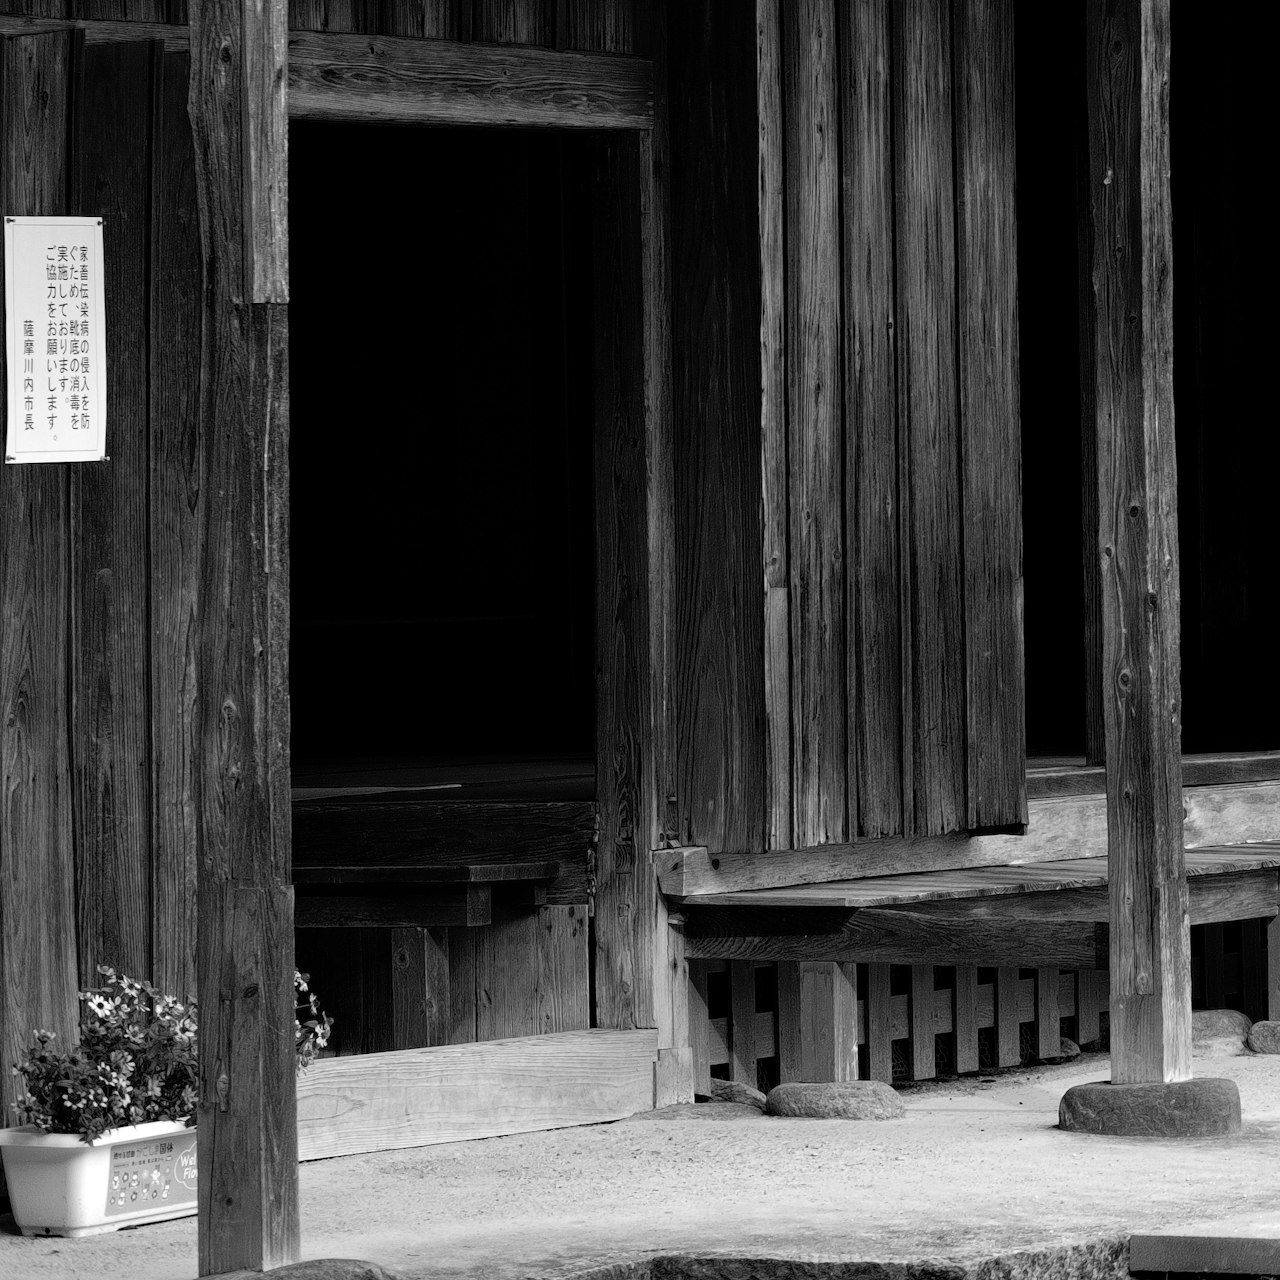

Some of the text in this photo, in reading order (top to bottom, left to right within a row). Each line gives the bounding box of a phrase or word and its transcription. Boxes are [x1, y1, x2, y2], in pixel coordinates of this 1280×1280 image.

[23, 320, 34, 431] 薩摩川内市長
[46, 245, 58, 442] ご協力をお願いします。
[57, 246, 69, 403] 実施しております。
[69, 246, 79, 430] ぐため、靴底の消毒を
[79, 246, 90, 430] 家畜伝染病の侵入を防
